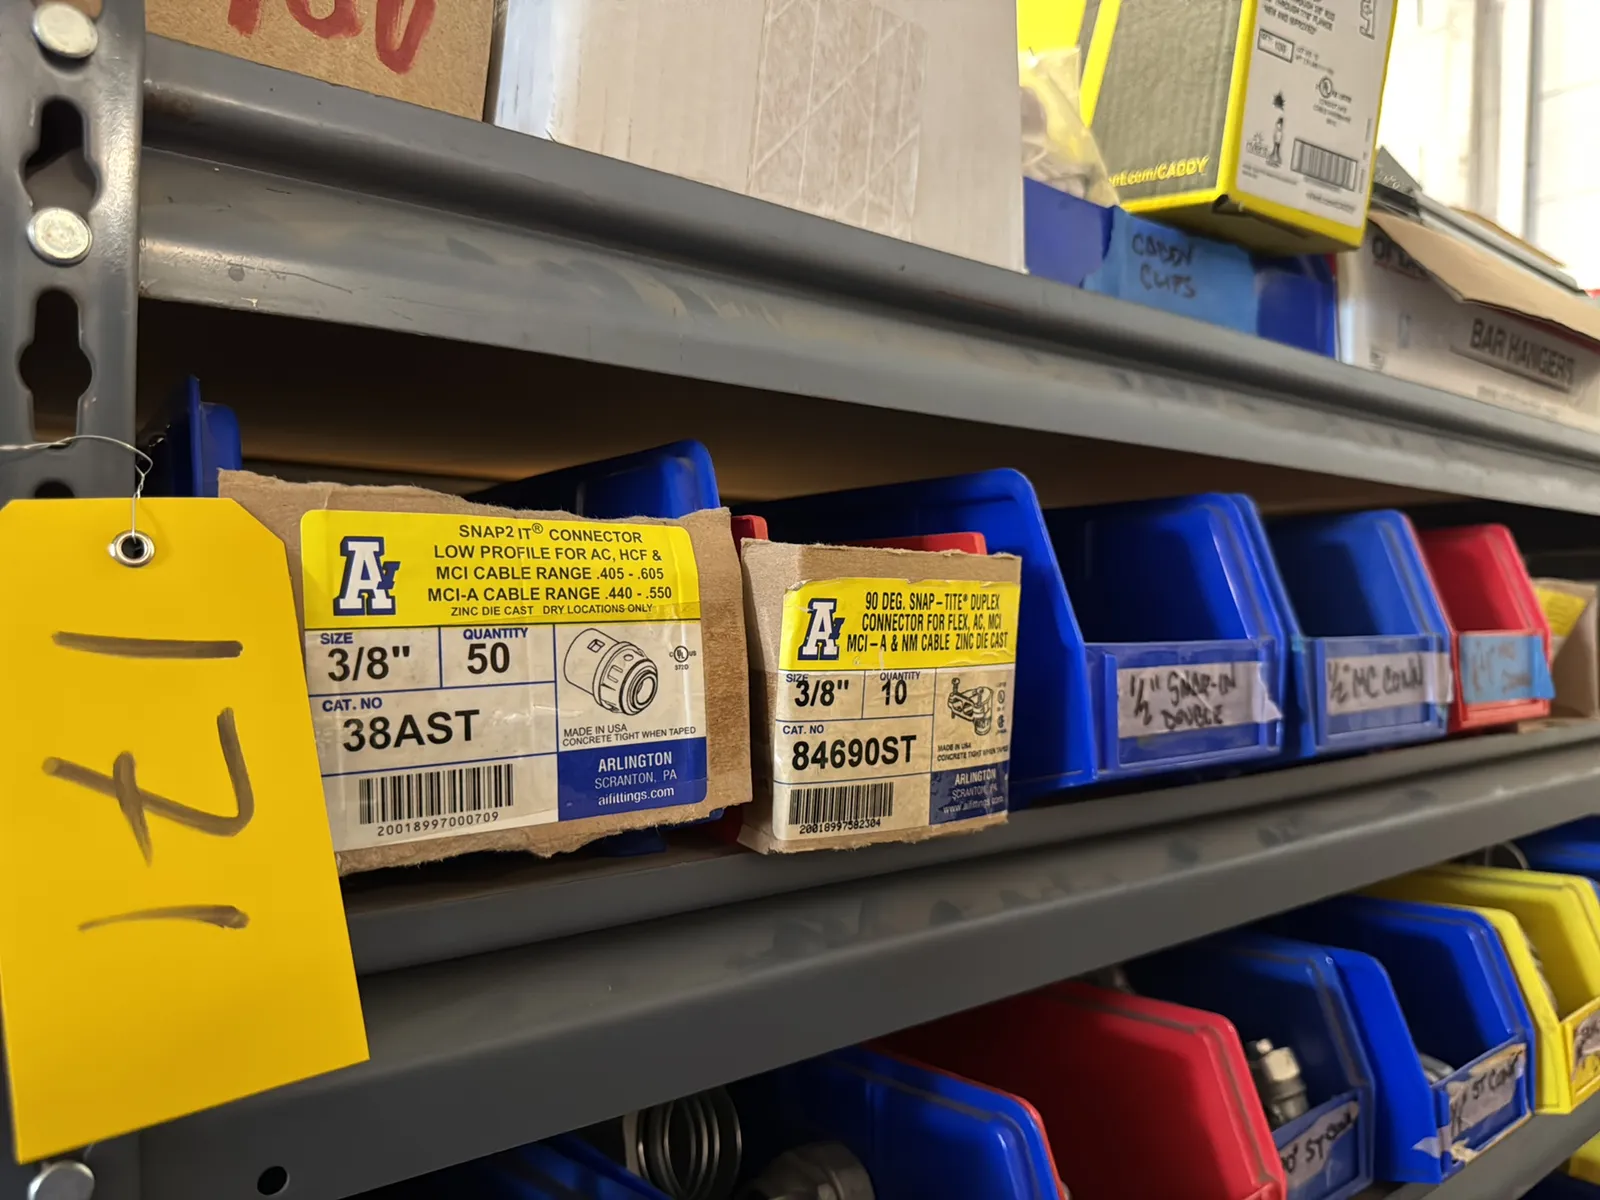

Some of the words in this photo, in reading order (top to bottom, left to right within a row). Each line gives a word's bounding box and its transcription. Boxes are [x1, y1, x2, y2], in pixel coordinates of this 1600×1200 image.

[1470, 317, 1507, 357] BAR
[1507, 332, 1575, 386] HANGERS
[459, 524, 515, 539] SNAP2
[549, 529, 643, 543] CONNECTOR
[434, 545, 475, 559] LOW
[481, 546, 551, 560] PROFILE
[555, 547, 587, 560] FOR
[591, 548, 617, 562] AC,
[620, 549, 647, 561] HCF
[652, 549, 662, 561] &
[436, 566, 468, 580] MCI
[474, 566, 531, 580] CABLE
[537, 566, 592, 580] RANGE
[596, 567, 624, 580] .405
[637, 567, 664, 580] .605
[428, 587, 479, 602] MCI-A
[484, 587, 540, 601] CABLE
[546, 586, 600, 601] RANGE
[605, 586, 633, 600] .440
[646, 586, 672, 599] .550
[865, 592, 878, 610] 90
[882, 592, 905, 611] DEG.
[970, 593, 1001, 610] DUPLEX
[451, 606, 479, 617] ZINC
[482, 605, 501, 616] DIE
[504, 605, 534, 615] CAST
[543, 604, 565, 615] DRY
[567, 604, 625, 614] LOCATIONS
[628, 603, 653, 613] ONLY
[862, 613, 925, 632] CONNECTOR
[926, 613, 946, 632] FOR
[948, 613, 970, 634] FLEX,
[973, 614, 986, 632] AC,
[988, 613, 1001, 630] MCI
[320, 632, 354, 645] SIZE
[463, 627, 528, 641] QUANTITY
[890, 634, 898, 652] &
[902, 634, 919, 652] NM
[921, 633, 950, 652] CABLE
[955, 633, 974, 651] ZINC
[976, 632, 988, 649] DIE
[991, 631, 1008, 649] CAST
[327, 645, 411, 683] 3/8"
[466, 642, 511, 676] 50
[786, 673, 808, 684] SIZE
[880, 671, 921, 682] QUANTITY
[794, 679, 849, 707] 3/8"
[881, 679, 907, 706] 10
[322, 698, 358, 713] CAT.
[360, 697, 382, 710] NO
[1160, 704, 1225, 731] DOUBLE
[342, 709, 480, 753] 38AST
[562, 734, 613, 748] CONCRETE
[615, 731, 640, 742] TIGHT
[641, 728, 667, 739] WHEN
[669, 726, 697, 737] TAPED
[563, 726, 593, 738] MADE
[595, 725, 605, 735] IN
[607, 723, 627, 734] USA
[783, 725, 807, 736] CAT.
[809, 725, 824, 735] NO
[598, 750, 673, 773] ARLINGTON
[792, 735, 917, 771] 84690ST
[937, 751, 966, 762] CONCRETE
[663, 769, 678, 781] PA
[954, 767, 997, 786] ARLINGTON
[598, 787, 675, 806] aifittings.com
[377, 811, 500, 838] 20018997000709
